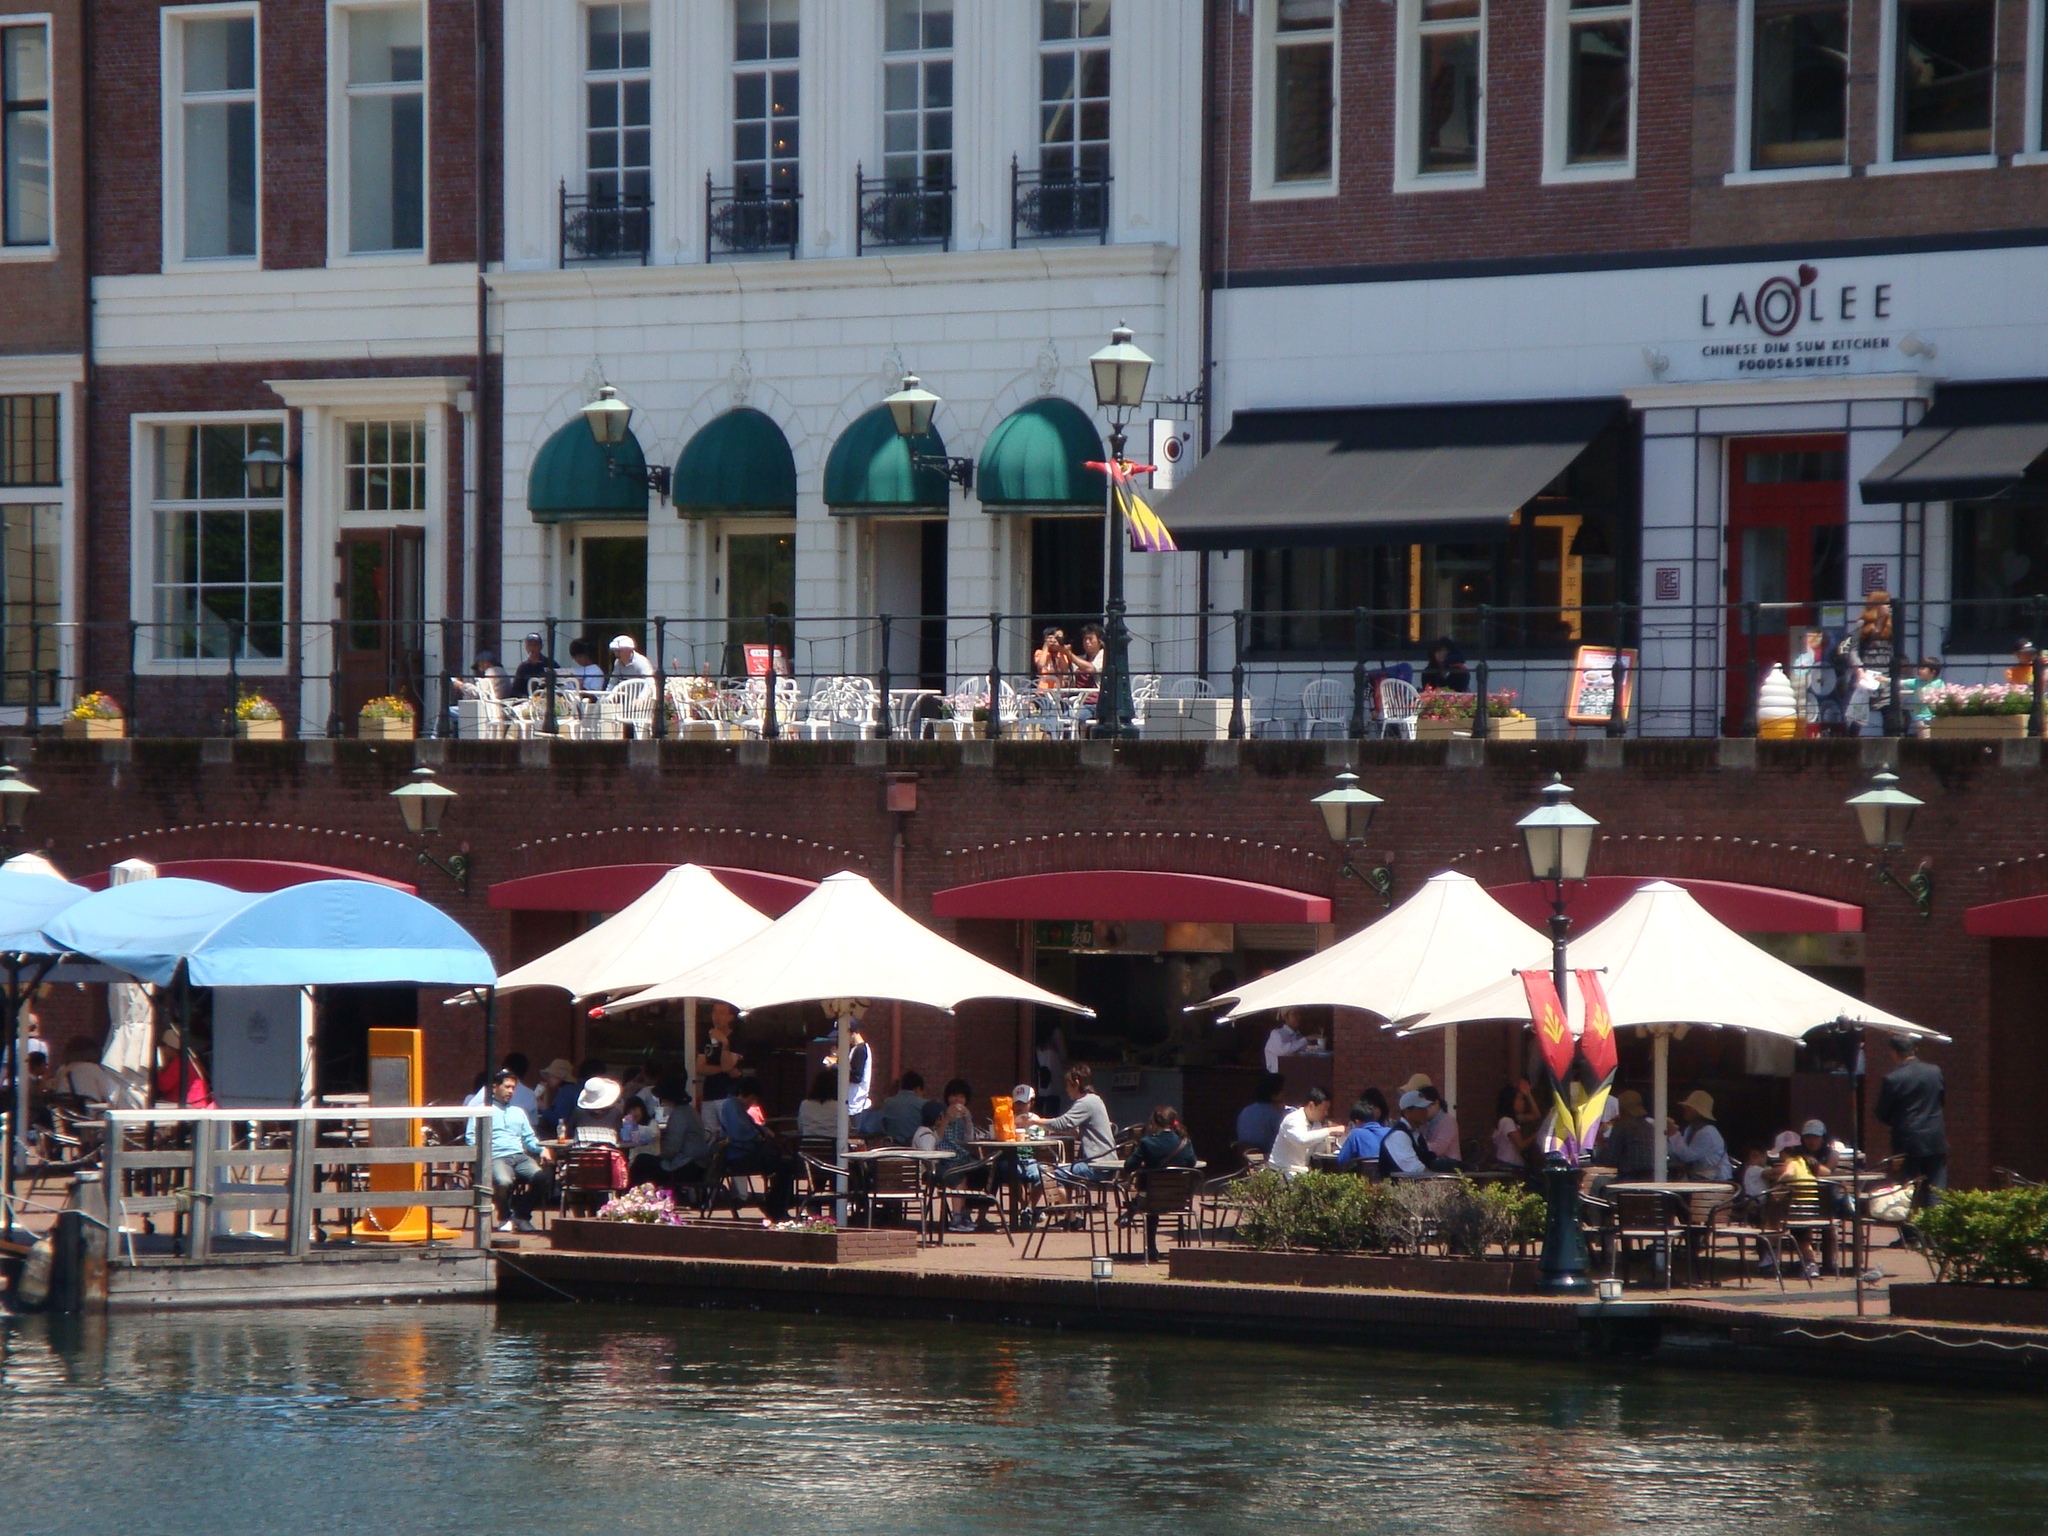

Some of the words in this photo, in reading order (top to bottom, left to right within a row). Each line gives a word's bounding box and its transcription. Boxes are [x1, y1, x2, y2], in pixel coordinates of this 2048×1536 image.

[1702, 343, 1757, 357] CHINESE
[1764, 342, 1790, 354] DIM
[1796, 340, 1825, 352] SUM
[1832, 337, 1890, 351] KITCHEN
[1738, 355, 1851, 370] FOODS&SWEETS
